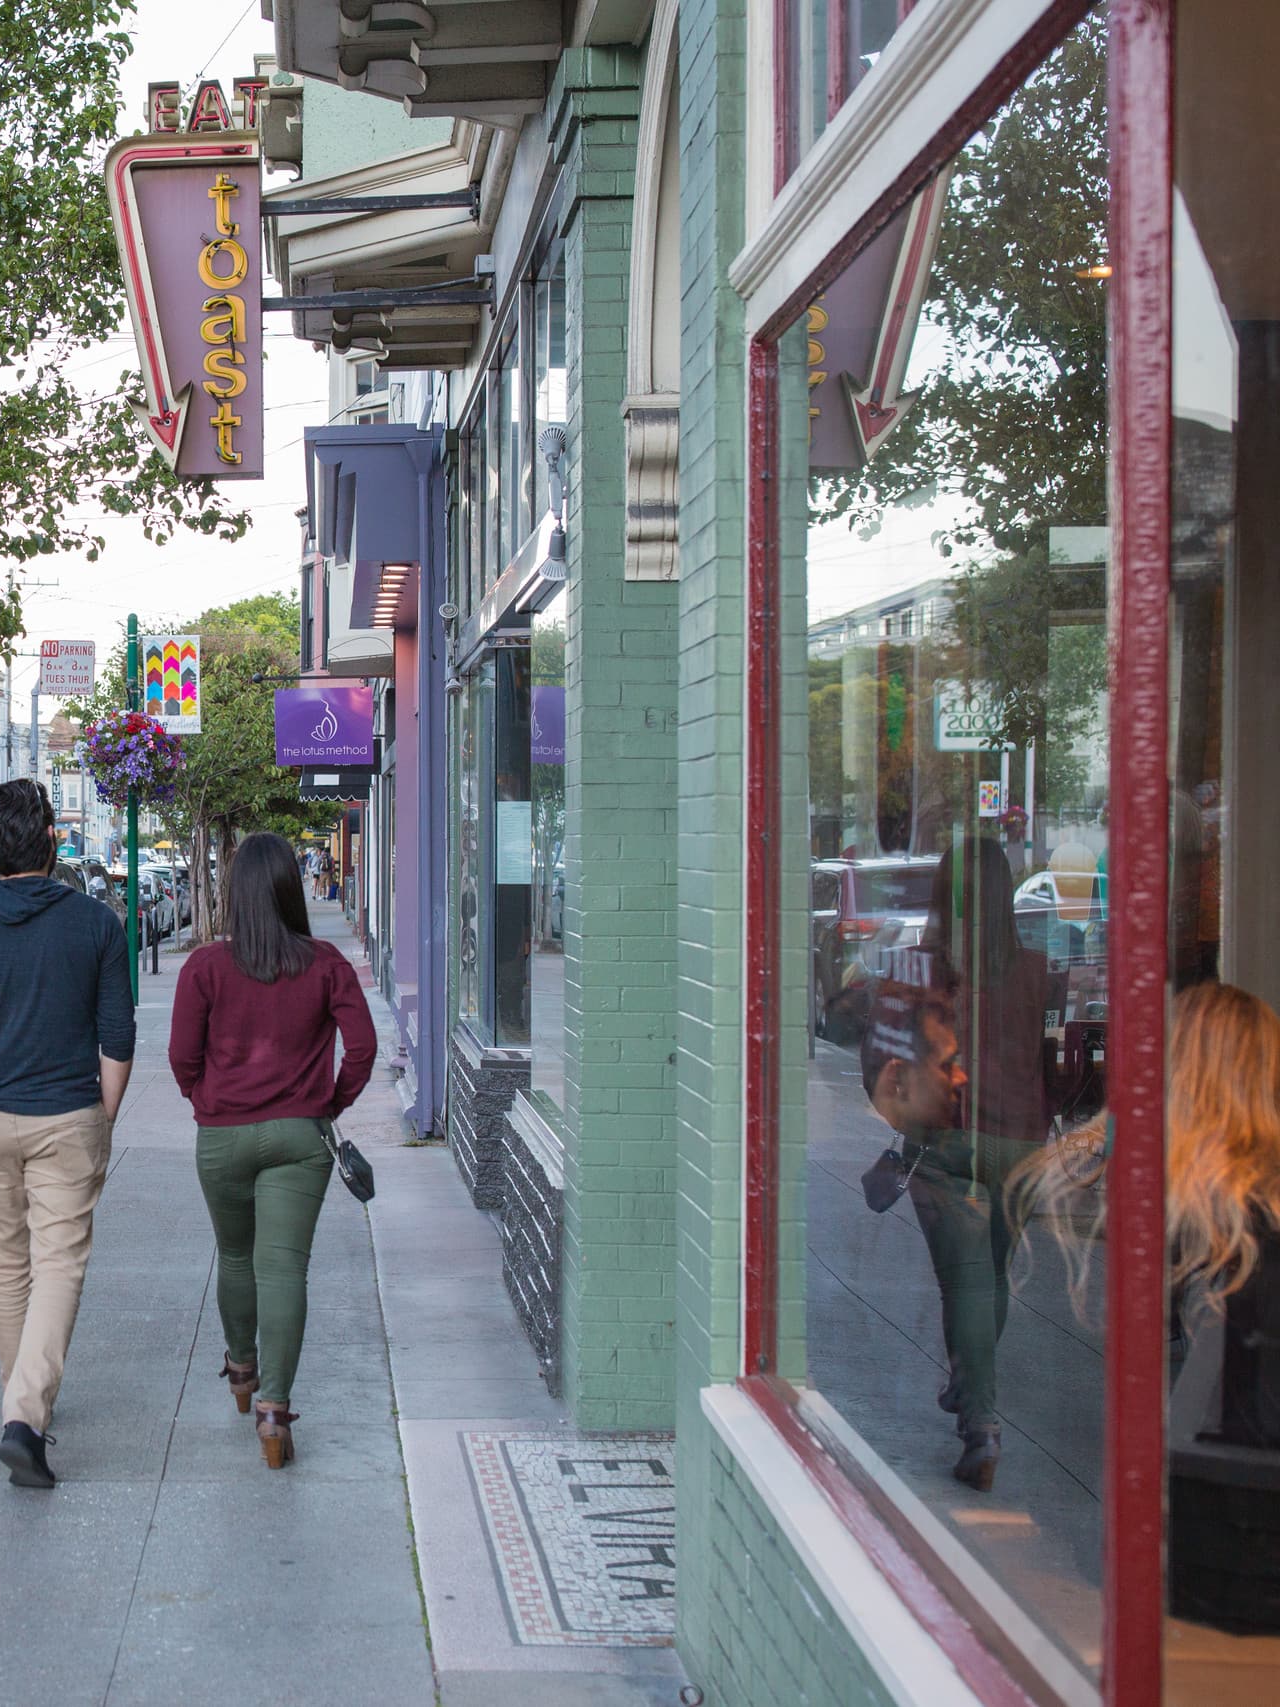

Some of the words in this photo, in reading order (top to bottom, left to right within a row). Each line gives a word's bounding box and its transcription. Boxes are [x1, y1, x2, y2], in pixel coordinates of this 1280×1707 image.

[148, 81, 268, 133] EAT
[198, 174, 248, 465] toast
[43, 641, 58, 656] NO
[60, 645, 93, 656] PARKING
[46, 674, 65, 683] TUES
[68, 674, 89, 684] THUR
[283, 746, 300, 757] the
[301, 745, 325, 757] lotus
[326, 744, 368, 755] method
